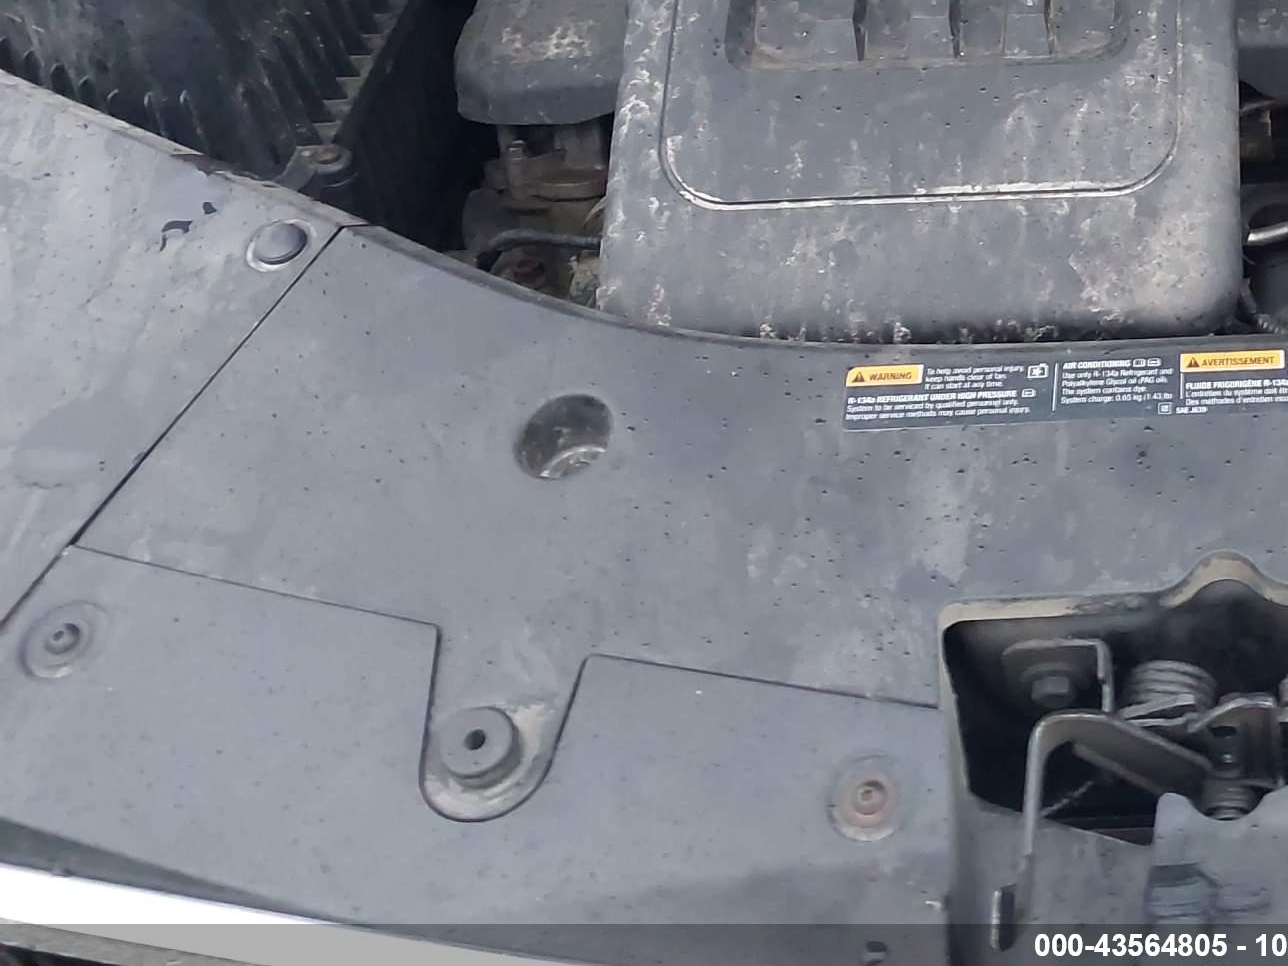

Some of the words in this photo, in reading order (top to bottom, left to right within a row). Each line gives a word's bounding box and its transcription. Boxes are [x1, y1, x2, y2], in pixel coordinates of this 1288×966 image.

[1062, 361, 1077, 370] AIR
[1078, 359, 1132, 369] CONDITIONING
[1202, 356, 1275, 367] AVERTISSEMENT
[973, 366, 1002, 374] personal
[868, 372, 913, 380] WARNING
[1186, 381, 1212, 390] FLUIDE
[876, 394, 930, 403] REFRIGERANT
[978, 390, 1018, 398] PRESSURE
[847, 405, 873, 413] System
